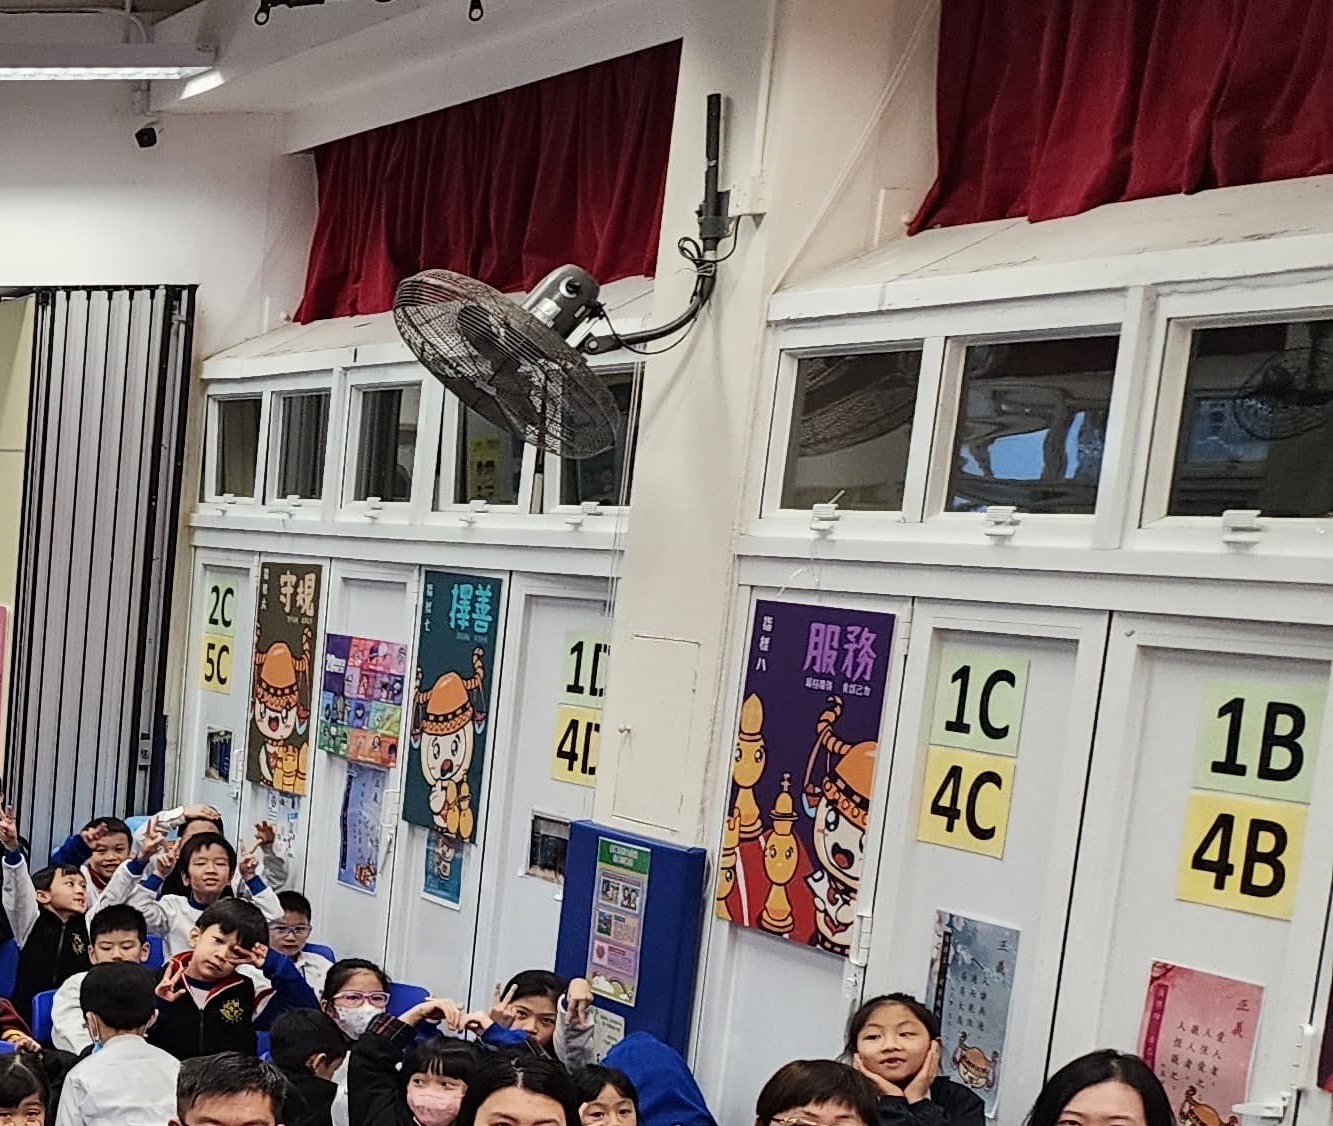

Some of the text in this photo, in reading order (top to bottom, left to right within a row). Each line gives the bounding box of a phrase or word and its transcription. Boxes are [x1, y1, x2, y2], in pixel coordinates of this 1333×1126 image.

[209, 585, 235, 627] 2C
[279, 570, 316, 616] 守規
[204, 637, 230, 685] 5C
[803, 622, 877, 681] 服務
[944, 665, 1016, 740] 1C
[1210, 697, 1307, 782] 1B
[930, 765, 1002, 841] 4C
[1191, 813, 1288, 899] 4B
[1232, 999, 1250, 1038] 正義
